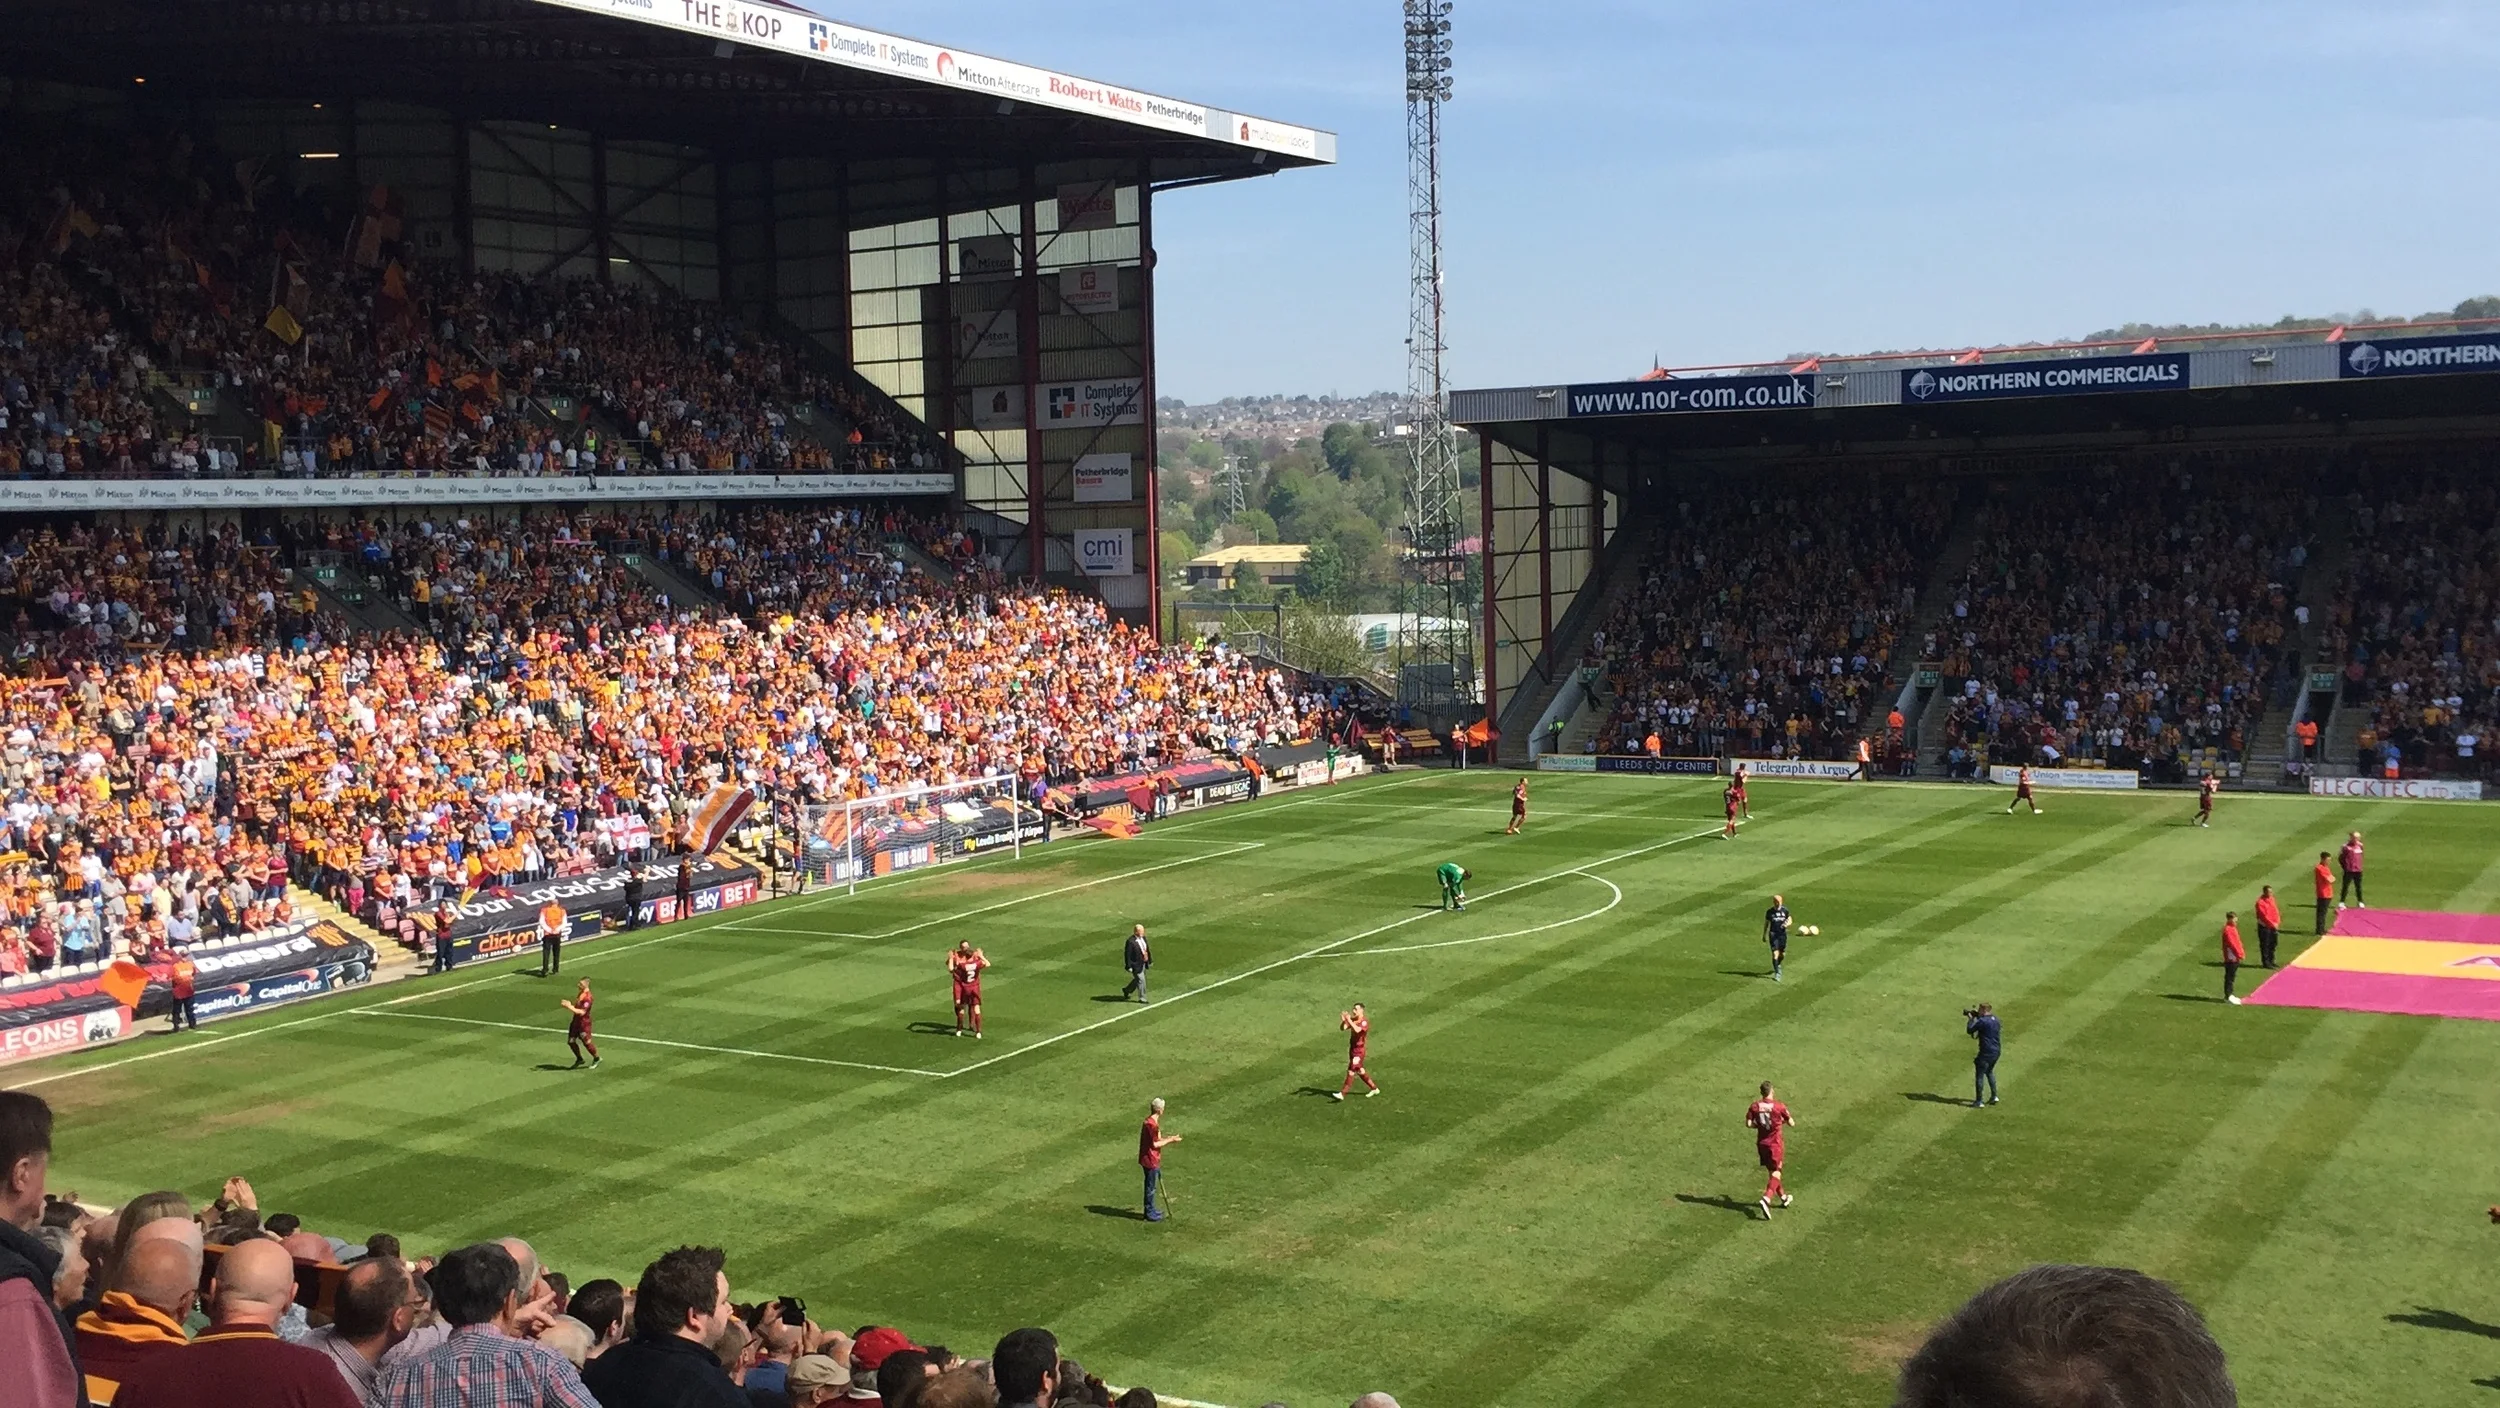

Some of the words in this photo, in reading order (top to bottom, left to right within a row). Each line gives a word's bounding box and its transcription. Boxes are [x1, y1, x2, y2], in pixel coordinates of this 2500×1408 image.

[682, 0, 721, 27] THE
[743, 11, 783, 40] KOP
[831, 31, 876, 58] Complete
[879, 43, 889, 60] IT
[890, 45, 929, 69] Systems
[958, 66, 996, 87] Mitton
[1048, 76, 1104, 104] Robert
[1106, 90, 1142, 113] Watts
[1146, 101, 1203, 125] Petherbridge
[2384, 344, 2500, 368] NORTHERN
[1939, 371, 2041, 393] NORTHERN
[2045, 363, 2180, 387] COMMERCIALS
[1085, 382, 1134, 400] Complete
[1574, 379, 1808, 413] www.nor-com.co.uk
[1080, 403, 1091, 418] IT
[1093, 400, 1138, 420] Systems
[1075, 466, 1129, 478] Petherbridge
[1083, 533, 1123, 557] cmi
[1615, 759, 1643, 770] LEEDS
[1675, 761, 1712, 772] CENTRE
[1754, 761, 1805, 776] Telegraph
[1808, 763, 1817, 774] &
[1820, 764, 1850, 776] Argus
[2033, 769, 2060, 779] Union
[1231, 781, 1251, 794] LEGAC
[2311, 778, 2419, 798] ELECKTEC
[2424, 787, 2449, 799] LTD
[963, 836, 976, 852] Fly
[1024, 826, 1044, 838] Airpor
[514, 878, 599, 908] Local
[695, 887, 720, 911] sky
[724, 883, 754, 904] BET
[659, 901, 678, 918] BE
[478, 930, 513, 953] click
[516, 930, 535, 944] on
